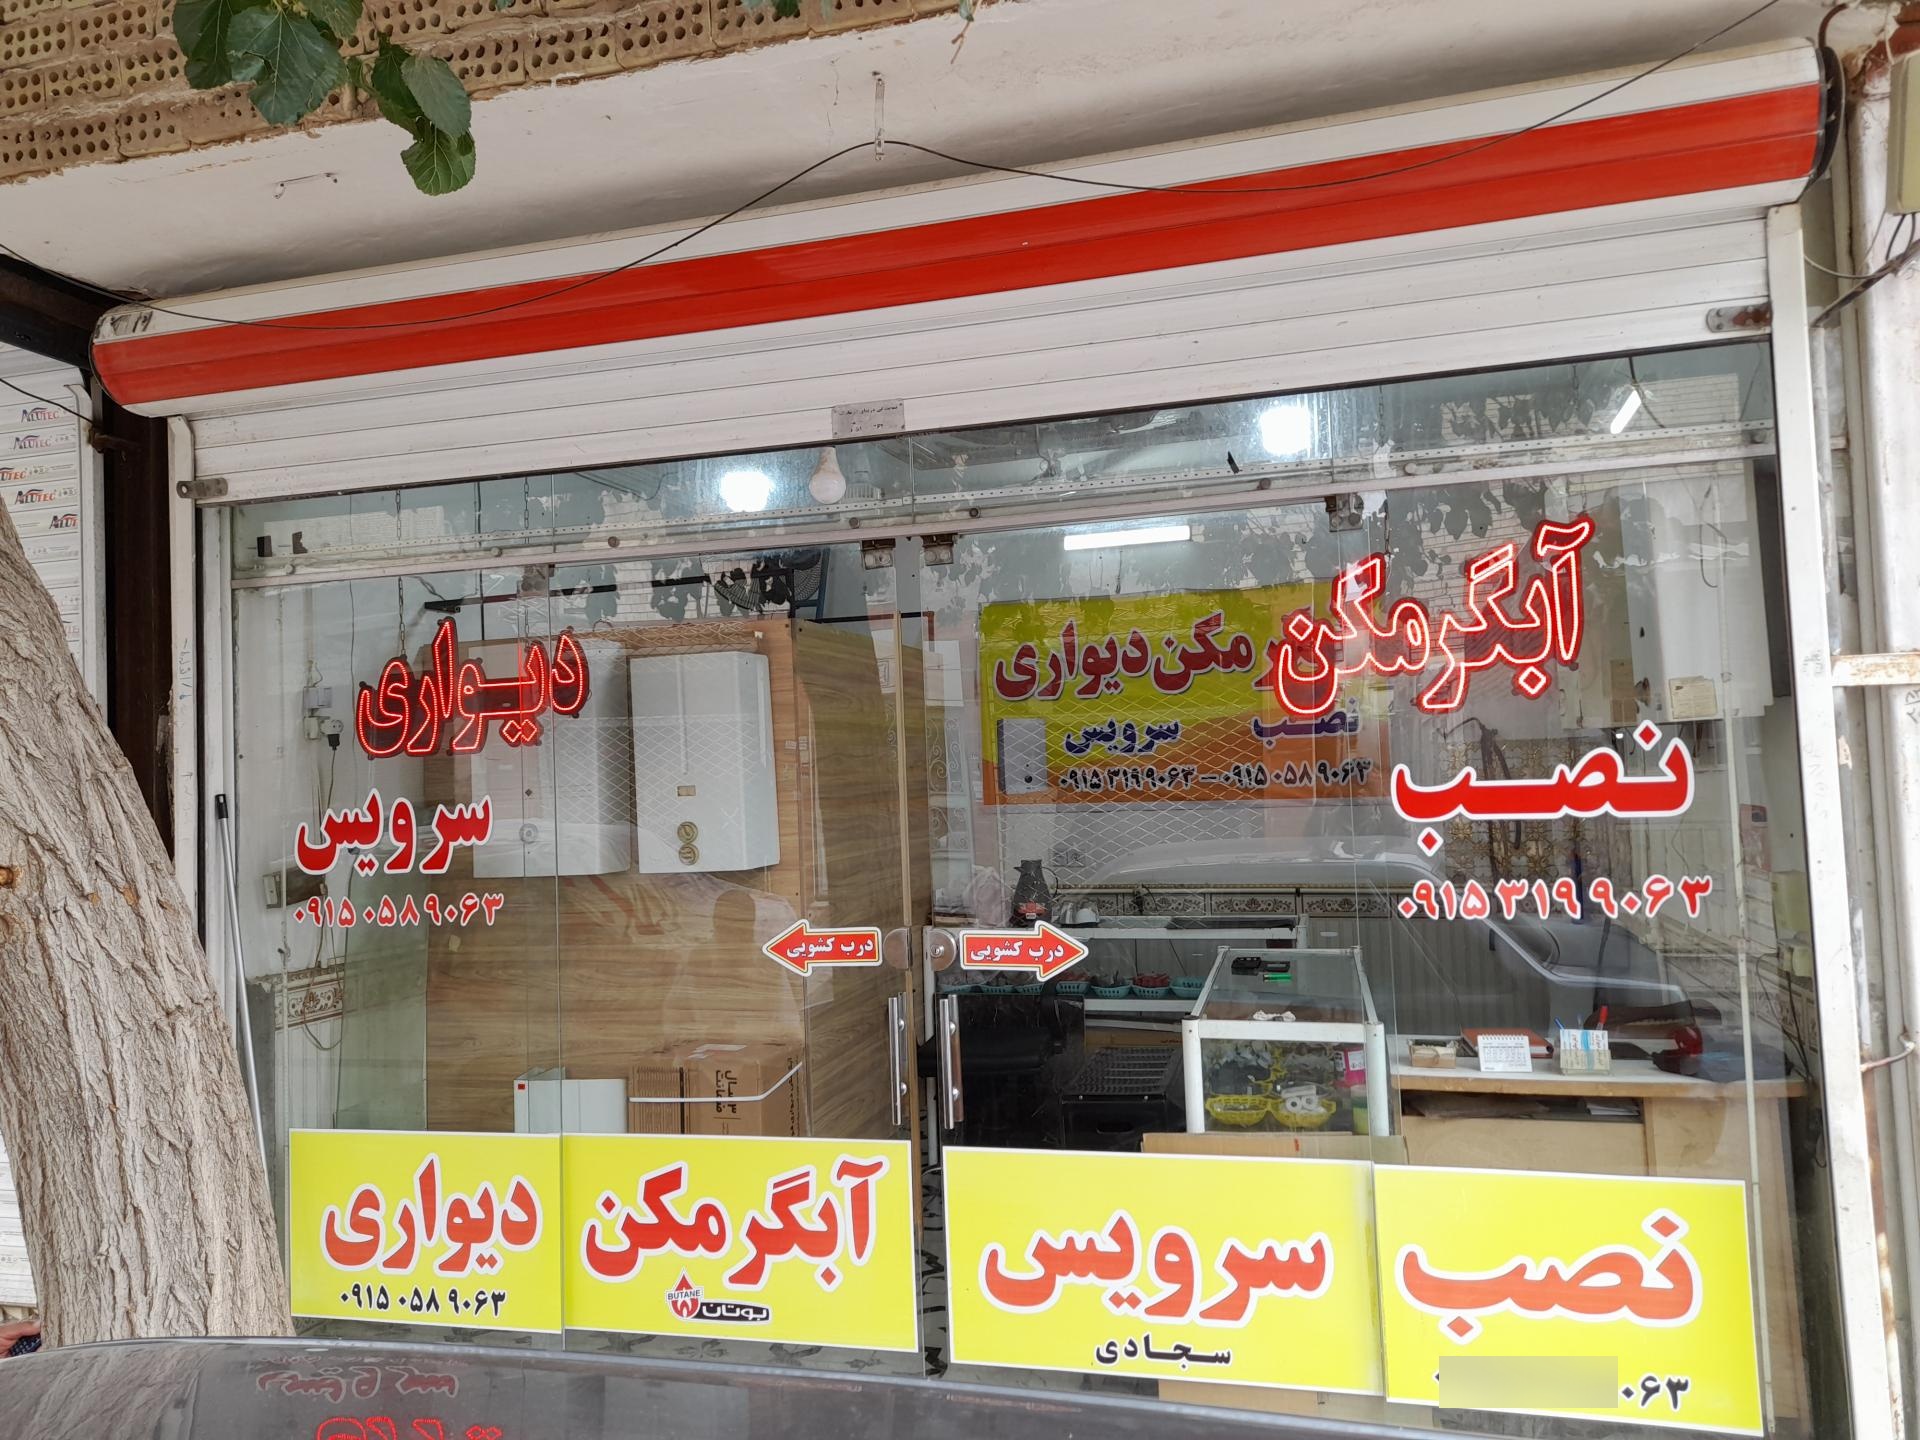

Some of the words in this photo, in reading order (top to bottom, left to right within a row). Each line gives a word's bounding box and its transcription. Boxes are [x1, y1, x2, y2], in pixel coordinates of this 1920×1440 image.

[1276, 518, 1593, 716] آبگرمکن
[356, 617, 587, 756] دیواری
[994, 618, 1152, 701] دیواری
[1064, 717, 1180, 756] سرویس
[1252, 697, 1361, 748] نصب
[1391, 720, 1694, 857] نصب
[295, 788, 494, 876] سرویس
[786, 937, 835, 958] کشویی
[841, 939, 874, 957] درب
[970, 941, 1022, 961] کشویی
[1029, 944, 1064, 962] درب
[320, 1152, 544, 1278] دیواری
[579, 1153, 890, 1292] آبگرمکن
[667, 1289, 701, 1301] BUTANE
[978, 1209, 1334, 1327] سرویس
[1395, 1207, 1703, 1345] نصب
[702, 1303, 768, 1321] بوتان
[1095, 1333, 1232, 1369] سجادی
